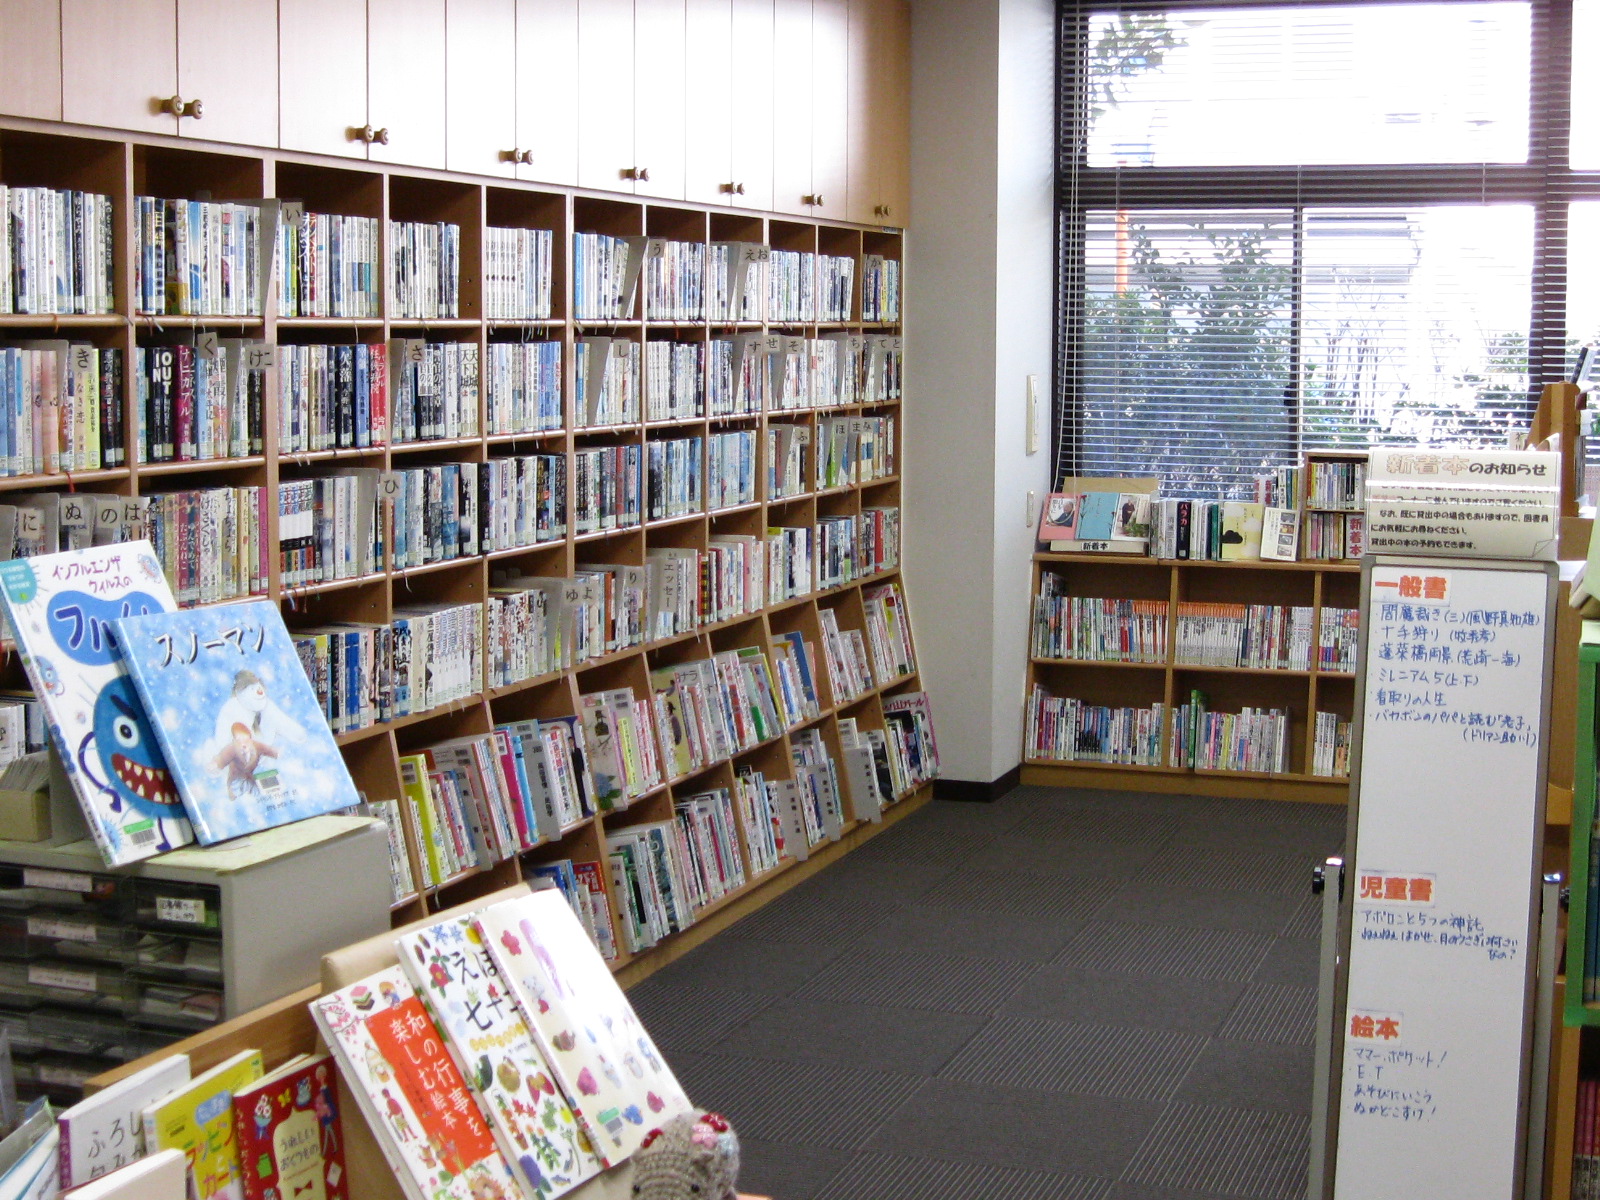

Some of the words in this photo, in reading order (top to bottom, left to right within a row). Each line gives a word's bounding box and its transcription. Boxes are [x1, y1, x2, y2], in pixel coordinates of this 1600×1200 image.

[204, 338, 214, 355] く
[411, 345, 423, 361] さ
[618, 345, 628, 357] し
[749, 341, 761, 353] す
[766, 338, 778, 349] せ
[788, 340, 799, 351] そ
[76, 348, 89, 368] き
[153, 353, 161, 383] IN
[161, 351, 172, 395] OUT
[1386, 454, 1547, 477] 新着本のお知らせ
[384, 478, 399, 494] ひ
[22, 512, 38, 532] に
[65, 503, 82, 521] ぬ
[101, 507, 118, 524] の
[124, 504, 141, 521] は
[1180, 503, 1189, 526] バラカ
[1350, 517, 1363, 557] 新着本
[52, 555, 121, 581] インフルエンザ
[629, 571, 637, 584] り
[663, 563, 675, 608] エッセー
[1374, 574, 1447, 600] 一般書
[153, 624, 265, 667] スノーマン
[1360, 875, 1432, 902] 児童書
[1350, 1014, 1399, 1040] 絵本
[389, 1017, 458, 1131] 楽しむ絵本
[406, 1009, 482, 1137] 和の行事を
